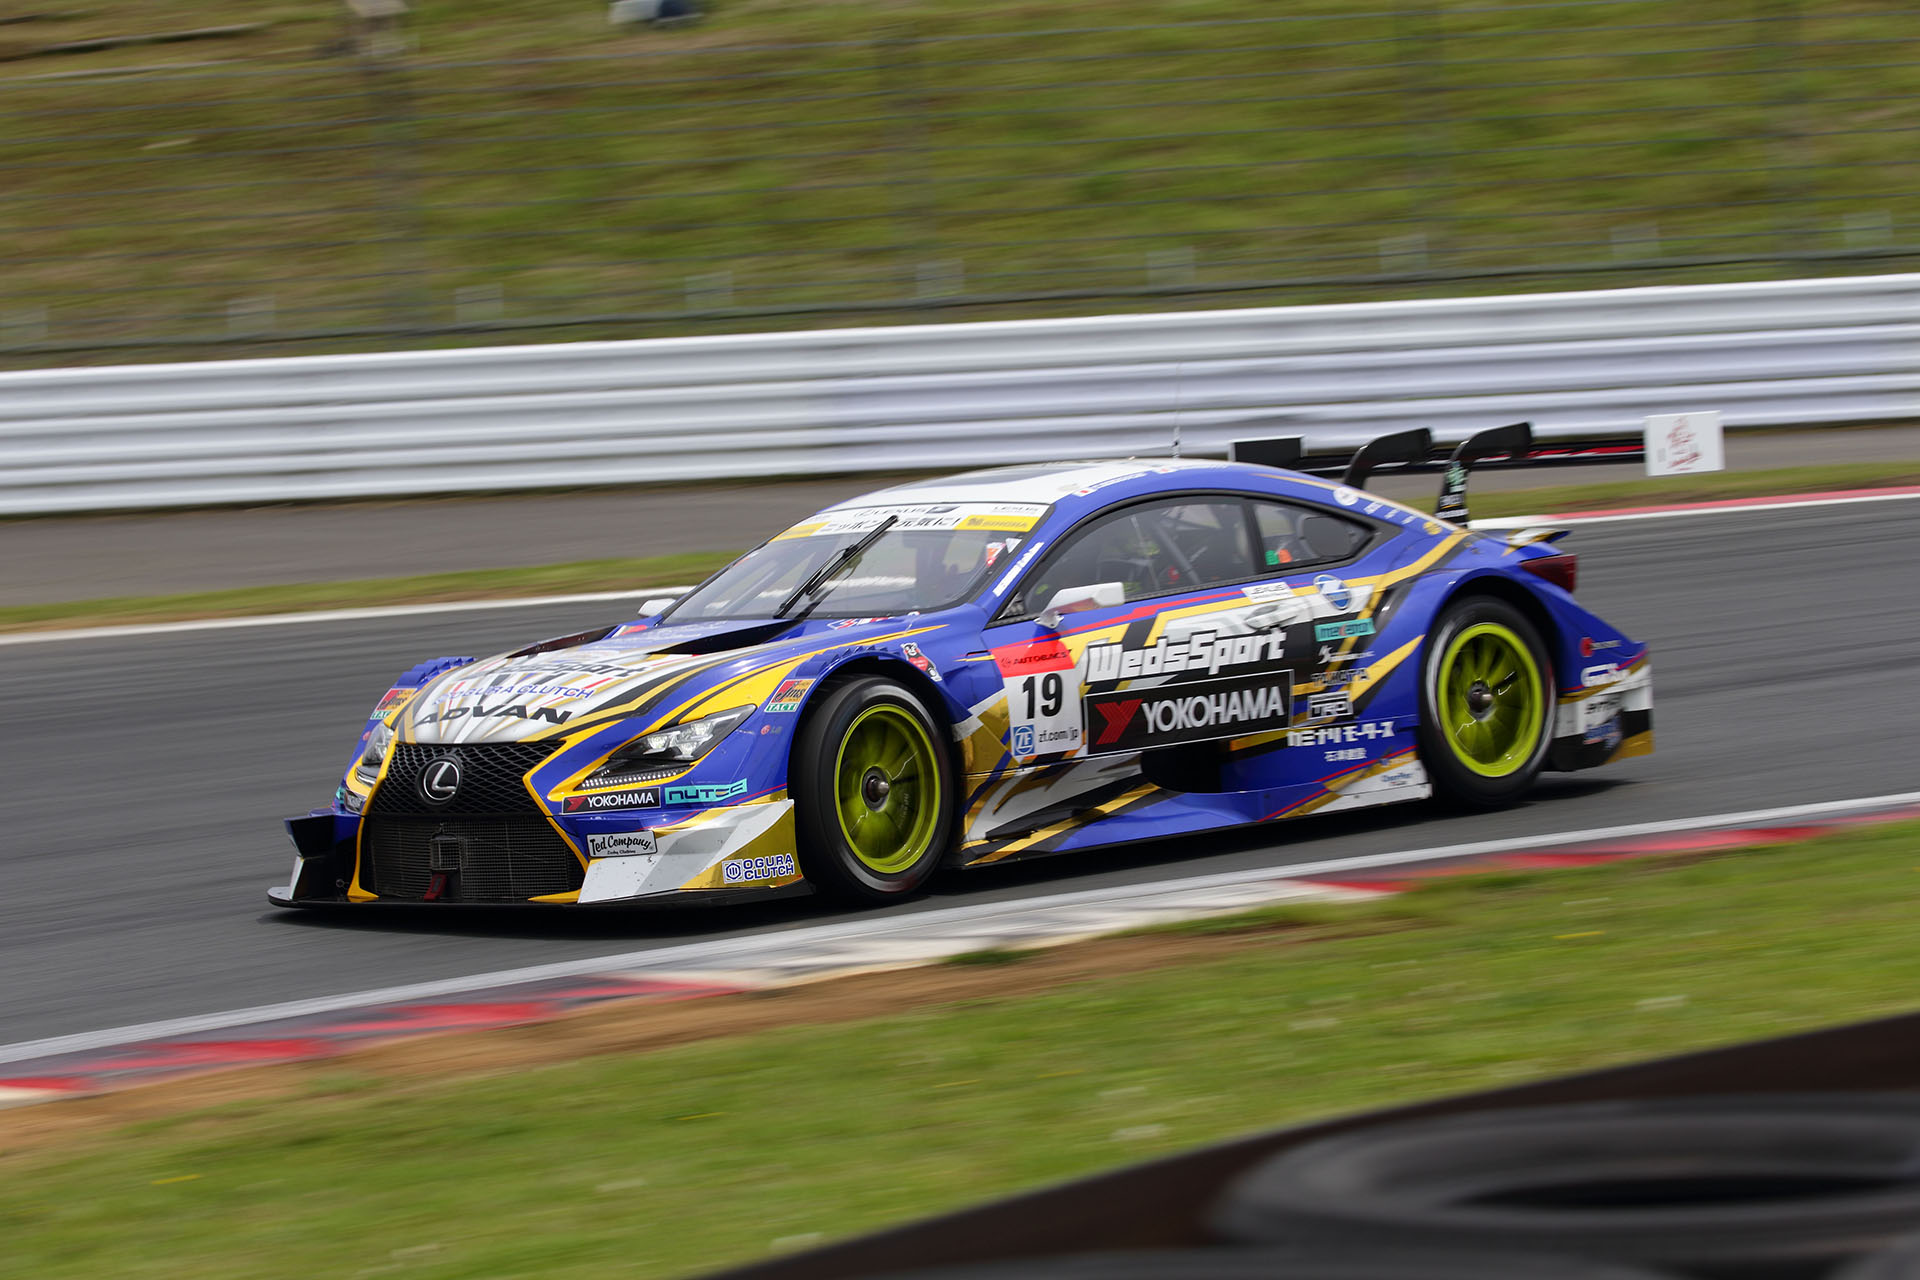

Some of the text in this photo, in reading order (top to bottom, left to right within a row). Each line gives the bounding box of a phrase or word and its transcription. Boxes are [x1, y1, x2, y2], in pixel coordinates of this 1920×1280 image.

[1012, 649, 1073, 665] AUTOBACS
[1086, 626, 1287, 682] WedsSport
[522, 684, 595, 699] CLUTCH
[1022, 672, 1064, 720] 19
[411, 704, 574, 730] ADVAN
[1141, 686, 1285, 734] YOKOHAMA
[587, 791, 655, 808] YOKOHAMA
[589, 835, 652, 856] Ted Company
[743, 854, 794, 869] OGURA
[743, 865, 794, 881] CLUTCH
